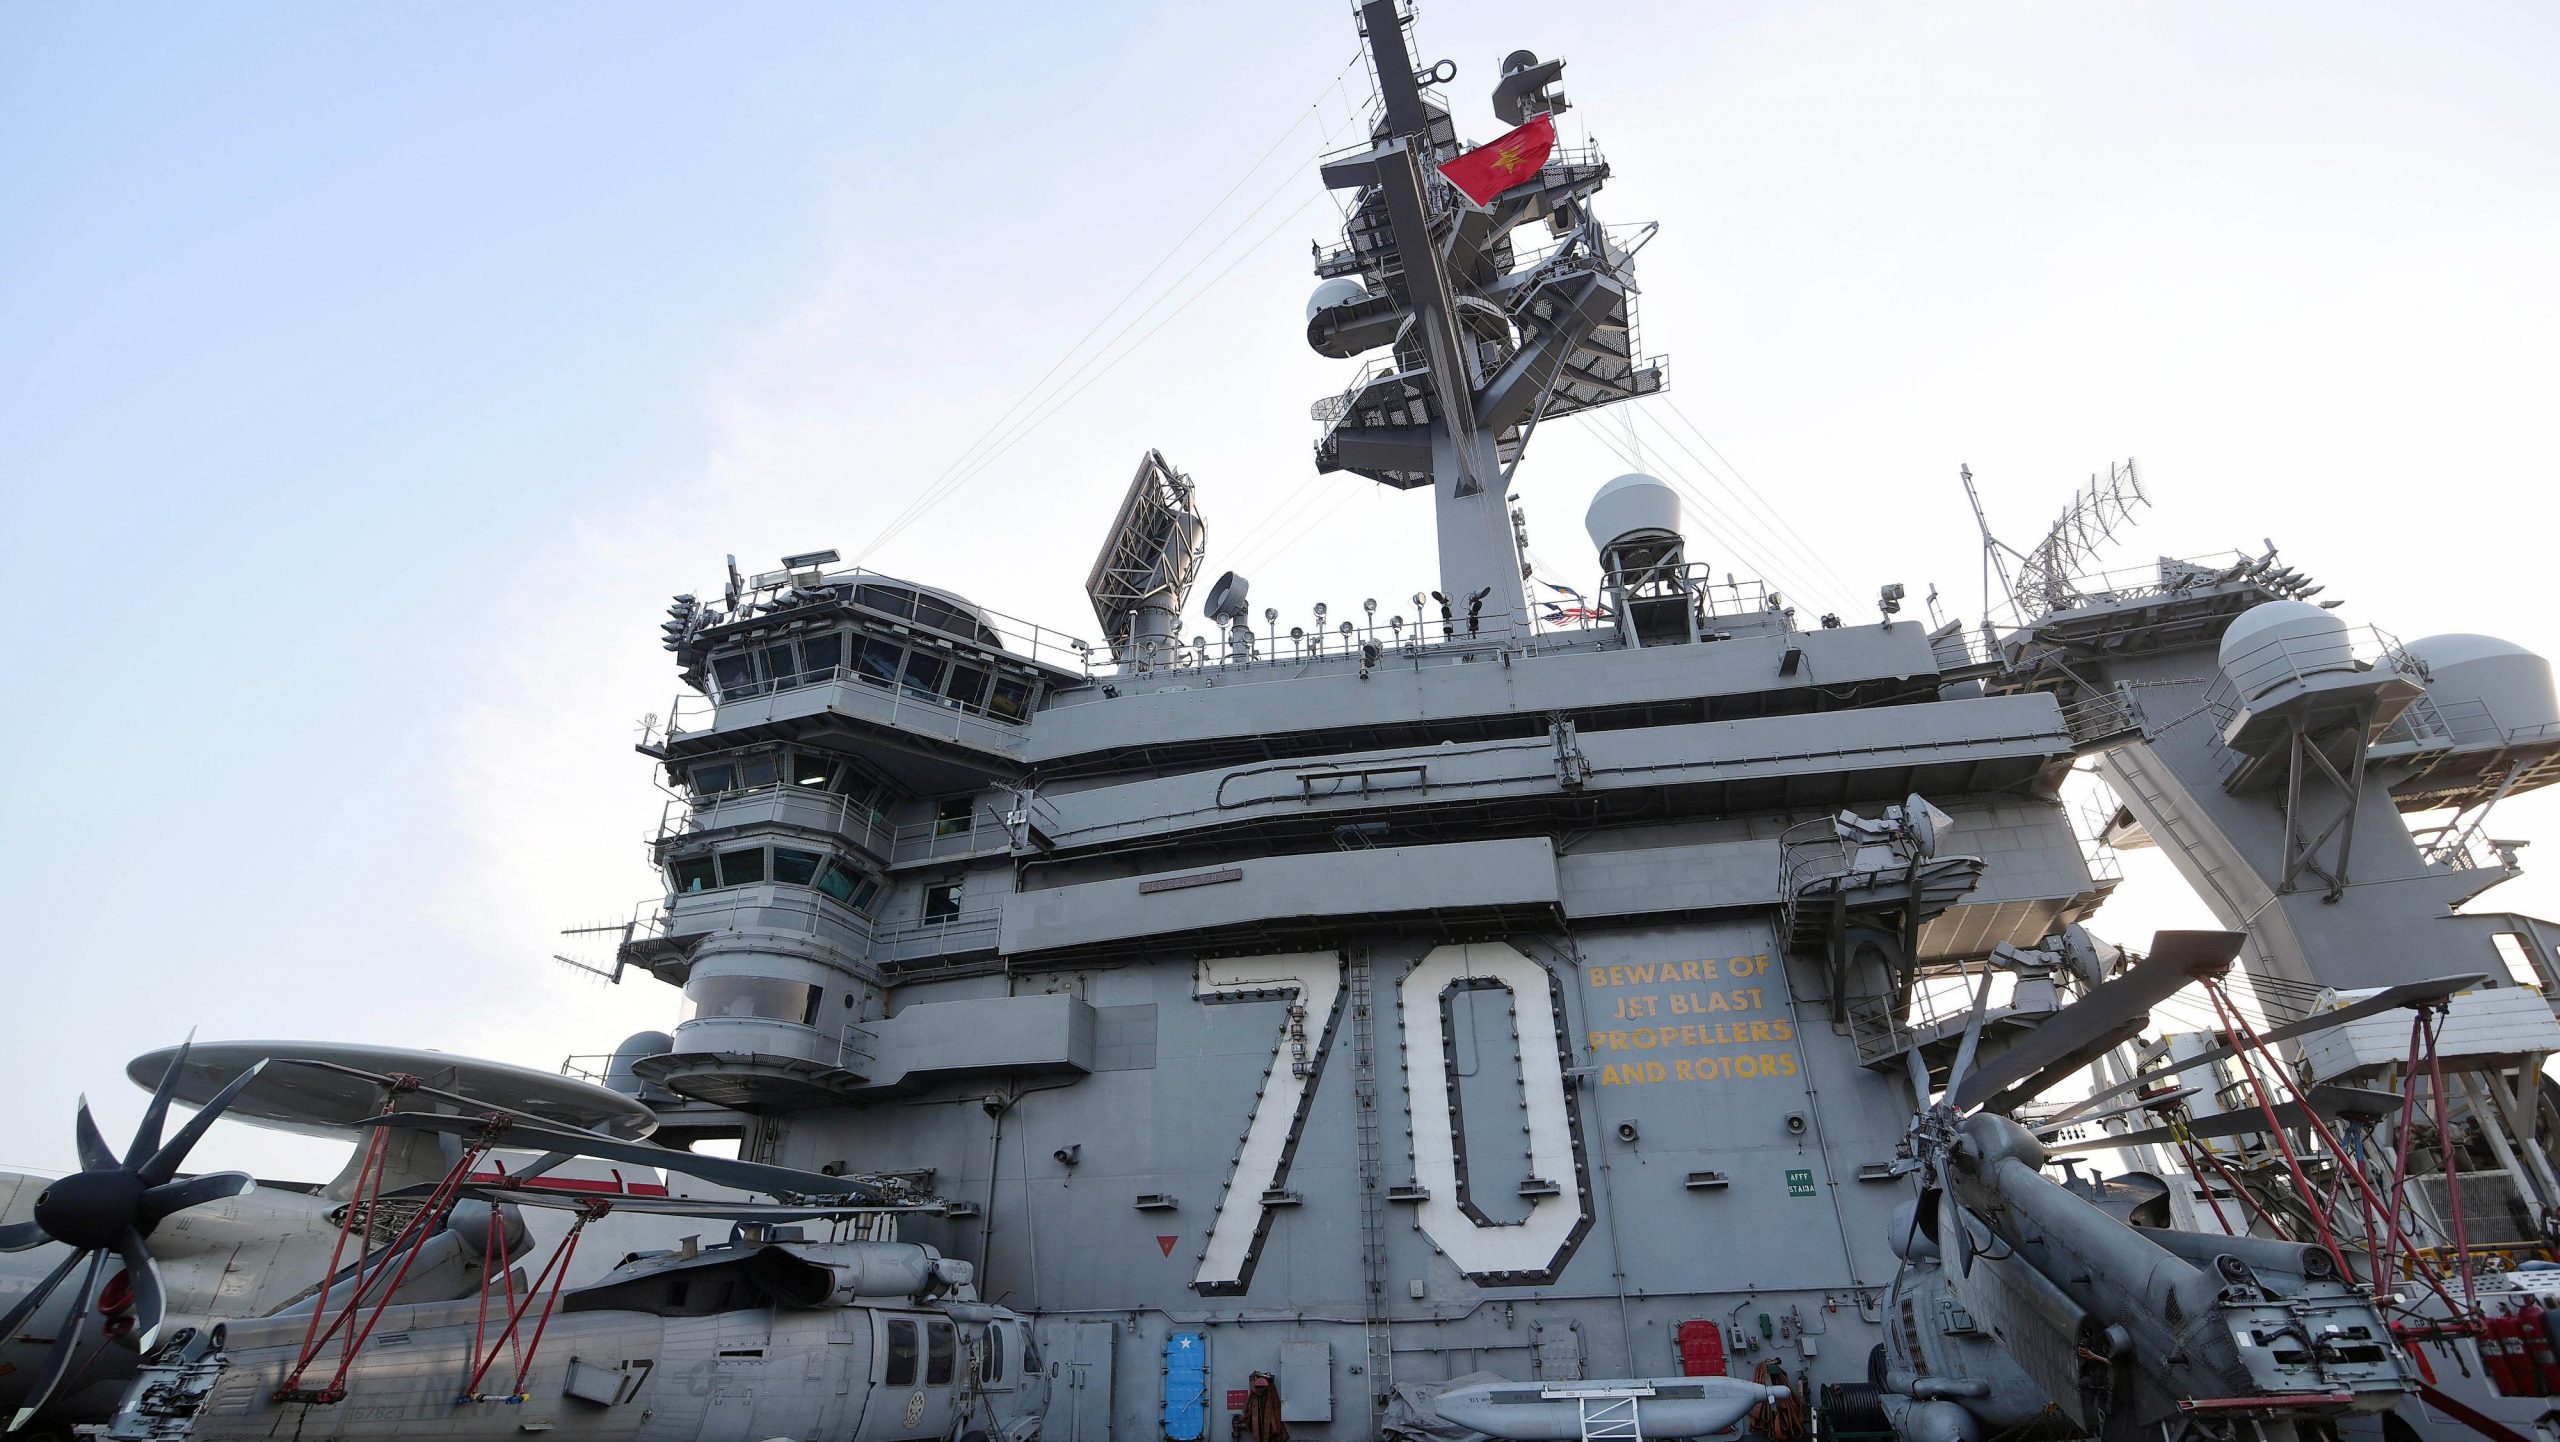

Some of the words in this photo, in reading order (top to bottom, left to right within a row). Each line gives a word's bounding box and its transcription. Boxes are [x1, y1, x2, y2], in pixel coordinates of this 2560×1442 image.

[1589, 959, 1718, 987] BEWARE
[1728, 954, 1770, 978] OF
[1614, 995, 1658, 1019] JET
[1670, 987, 1762, 1015] BLAST
[1589, 1018, 1793, 1053] PROPELLERS
[1601, 1060, 1666, 1086] AND
[1675, 1053, 1798, 1082] ROTORS
[1196, 942, 1595, 1296] 70
[1790, 1173, 1808, 1181] AFFF
